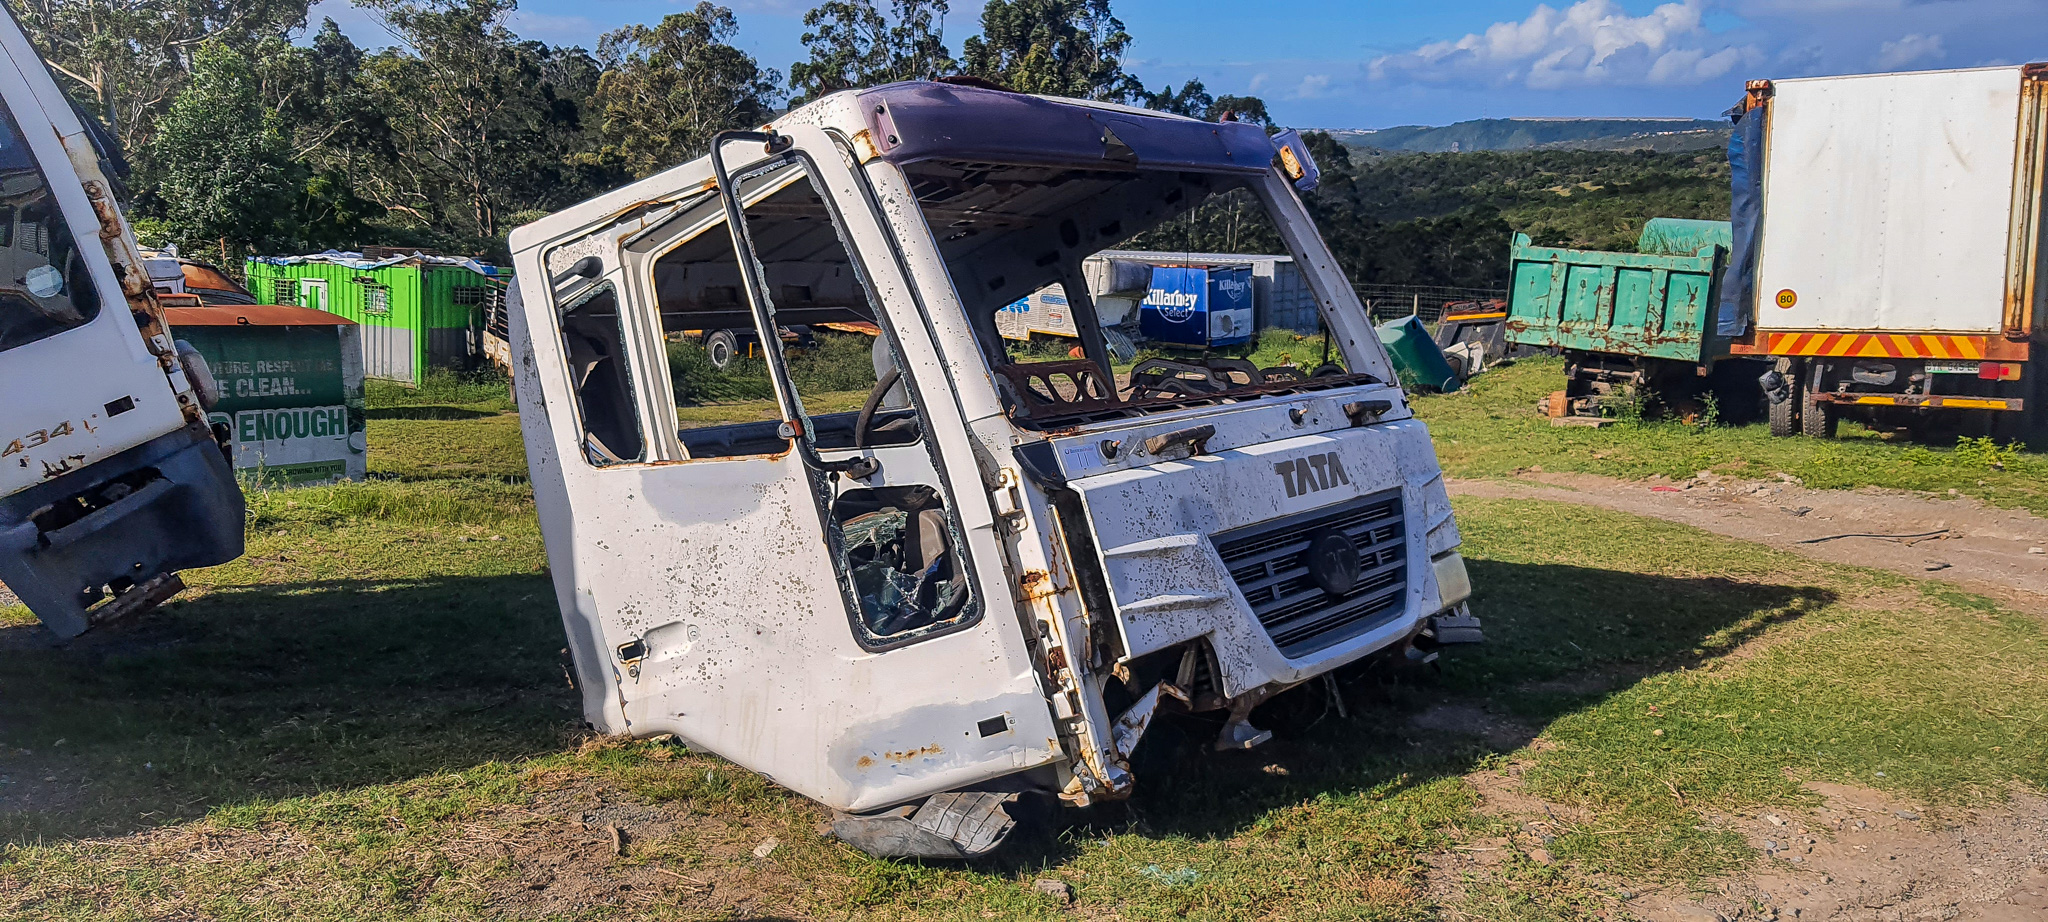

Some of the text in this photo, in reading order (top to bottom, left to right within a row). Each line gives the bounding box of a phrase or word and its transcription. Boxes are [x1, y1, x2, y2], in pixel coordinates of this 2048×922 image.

[1143, 289, 1198, 311] Killarney
[1780, 295, 1793, 304] 80
[1164, 307, 1189, 318] Select
[209, 361, 254, 375] UTURE,
[217, 379, 231, 399] E
[239, 409, 345, 442] ENOUGH
[1, 420, 75, 458] 434
[314, 465, 329, 473] WITH
[1273, 451, 1350, 498] TATA
